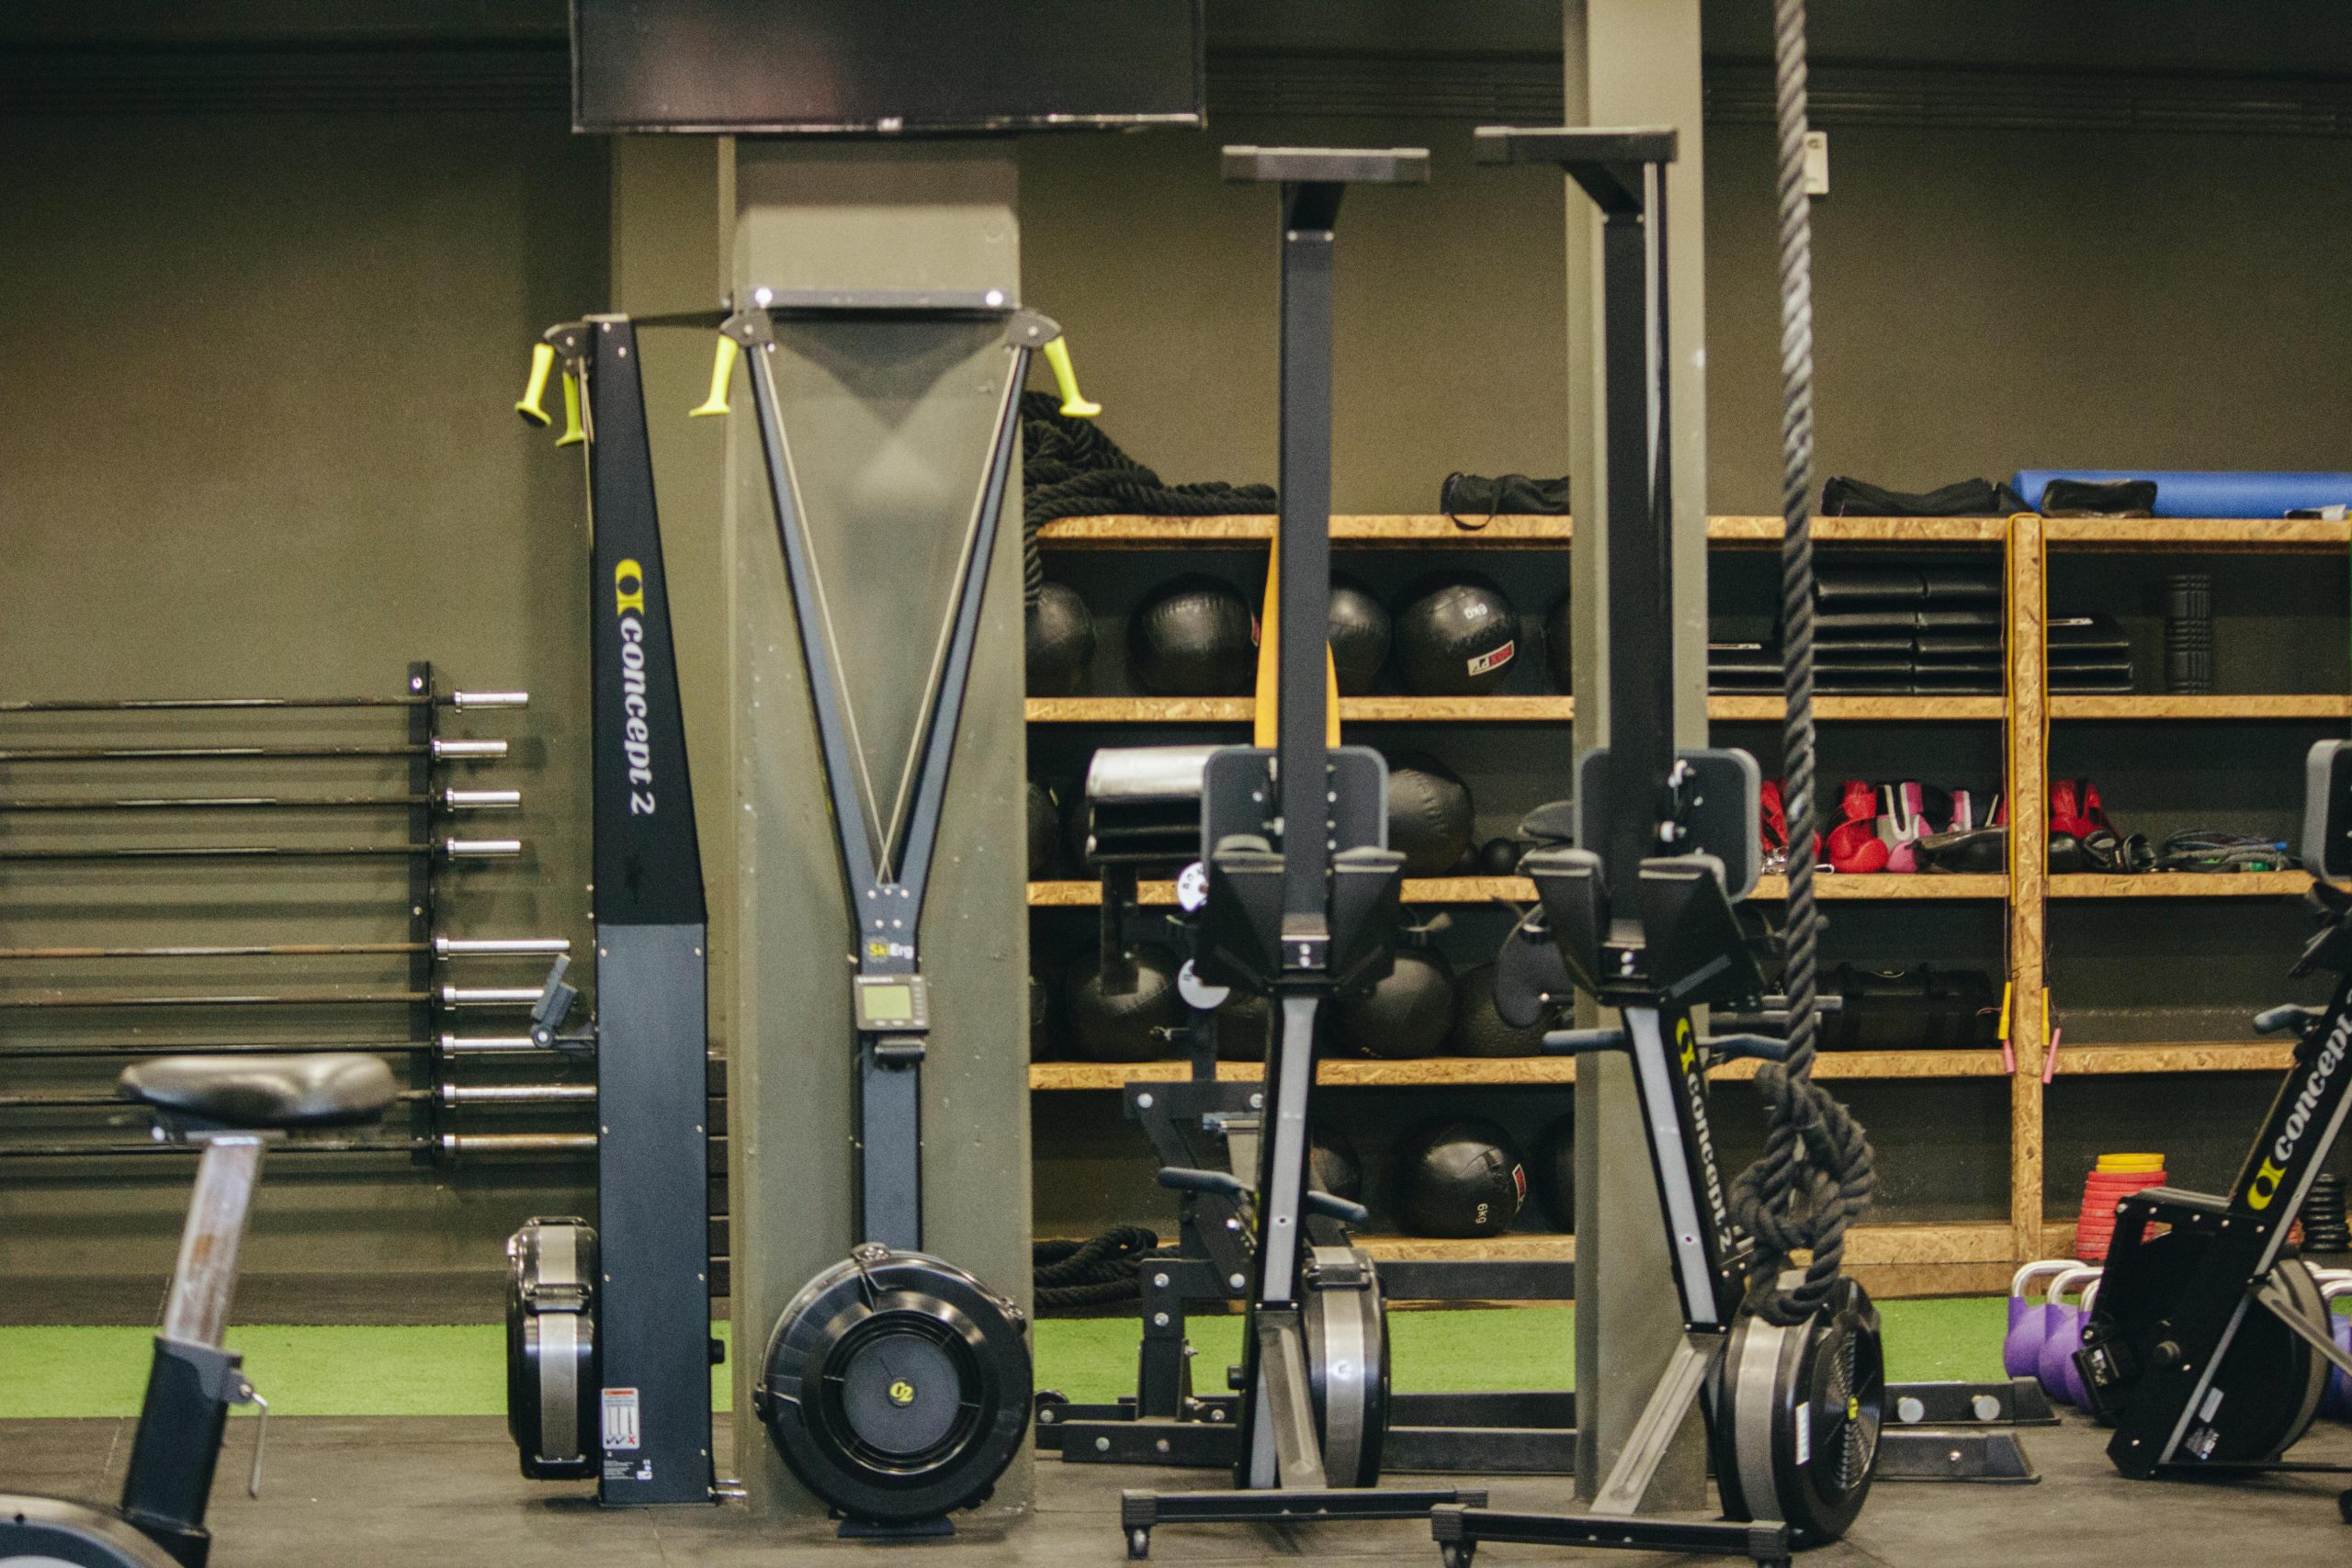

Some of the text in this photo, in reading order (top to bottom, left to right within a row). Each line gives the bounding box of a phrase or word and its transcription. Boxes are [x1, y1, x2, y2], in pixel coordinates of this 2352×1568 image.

[620, 616, 656, 816] concept 2
[1475, 1202, 1488, 1224] 6kg
[1687, 1072, 1726, 1226] concept
